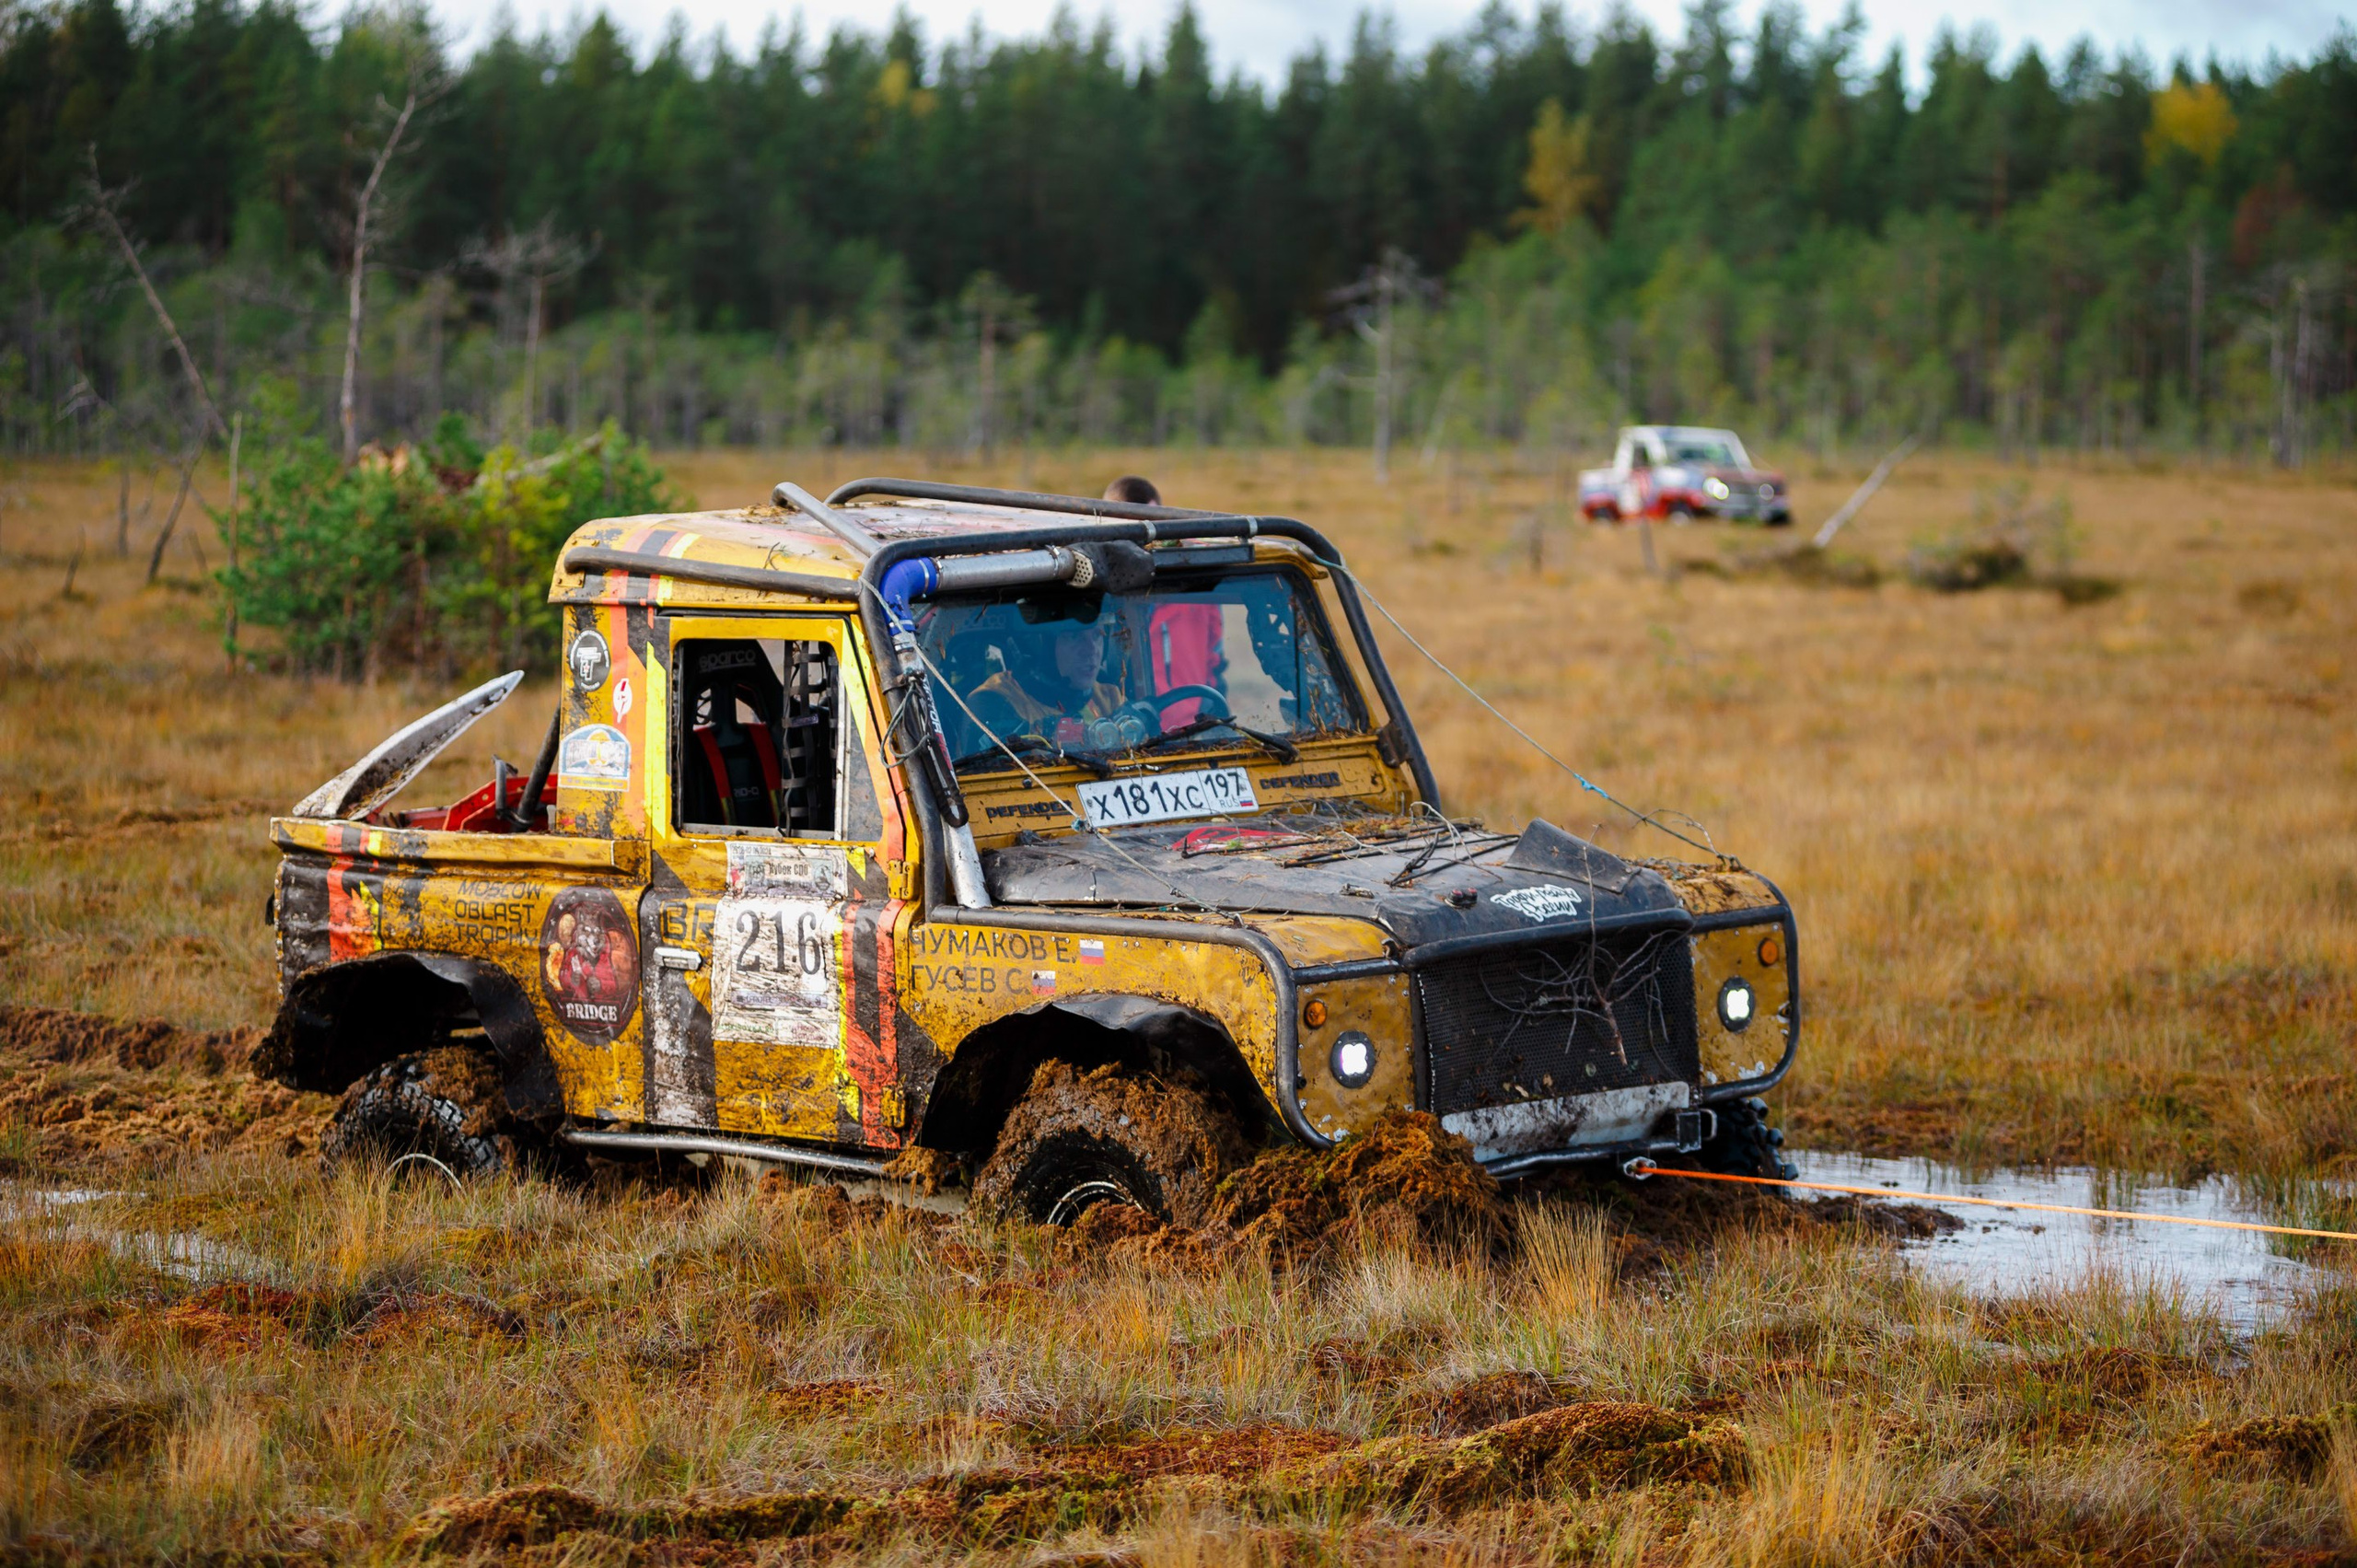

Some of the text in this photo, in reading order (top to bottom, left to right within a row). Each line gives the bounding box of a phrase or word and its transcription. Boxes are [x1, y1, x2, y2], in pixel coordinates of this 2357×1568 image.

[699, 648, 756, 671] sparco
[1204, 772, 1241, 799] 197
[1260, 772, 1341, 790] DEFENDER
[985, 799, 1074, 819] DEFENDER
[1219, 795, 1239, 808] RUS
[458, 879, 544, 900] MOSCOW
[455, 900, 534, 923] OBLAST
[454, 922, 538, 947] TROPHY
[737, 910, 820, 975] 216
[909, 927, 1047, 960] ЧУМАКОВ
[911, 965, 996, 993] ГУСЕВ
[566, 1003, 618, 1022] BRIDGE
